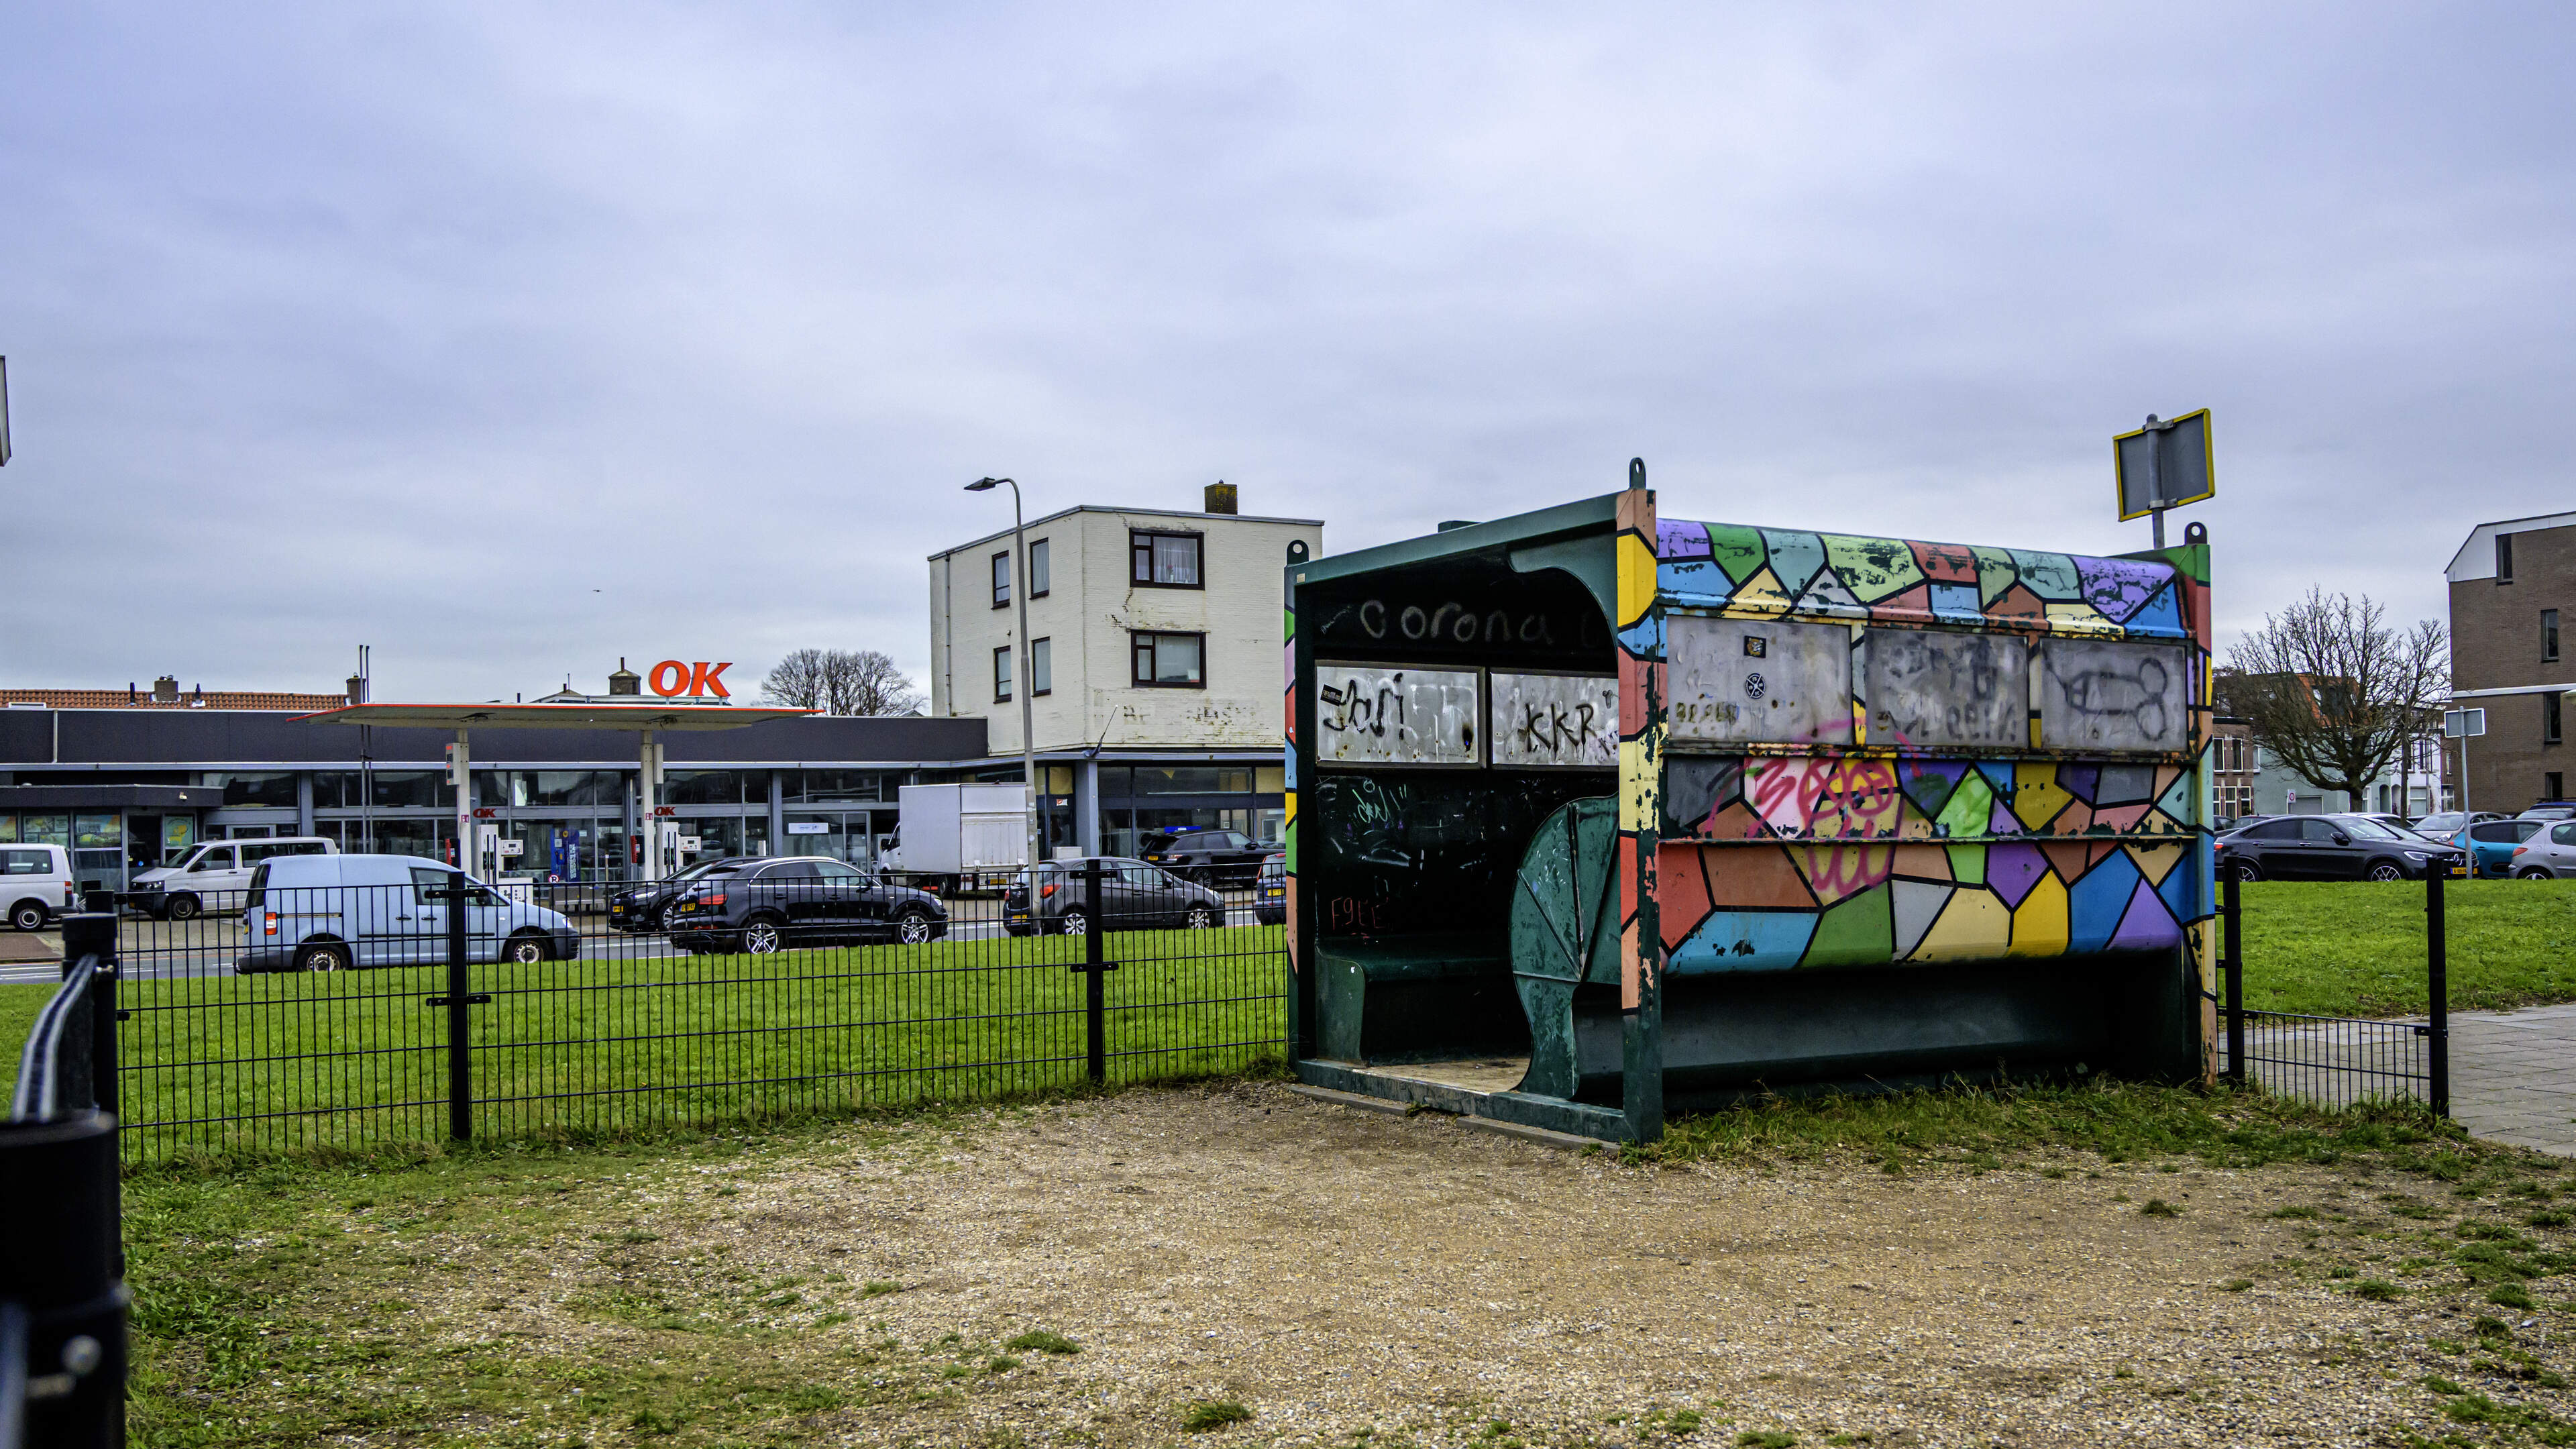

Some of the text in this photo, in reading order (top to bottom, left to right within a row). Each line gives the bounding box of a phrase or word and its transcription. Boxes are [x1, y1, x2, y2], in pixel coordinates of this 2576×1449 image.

[649, 660, 733, 697] OK
[473, 808, 496, 818] OK
[655, 806, 676, 816] OK
